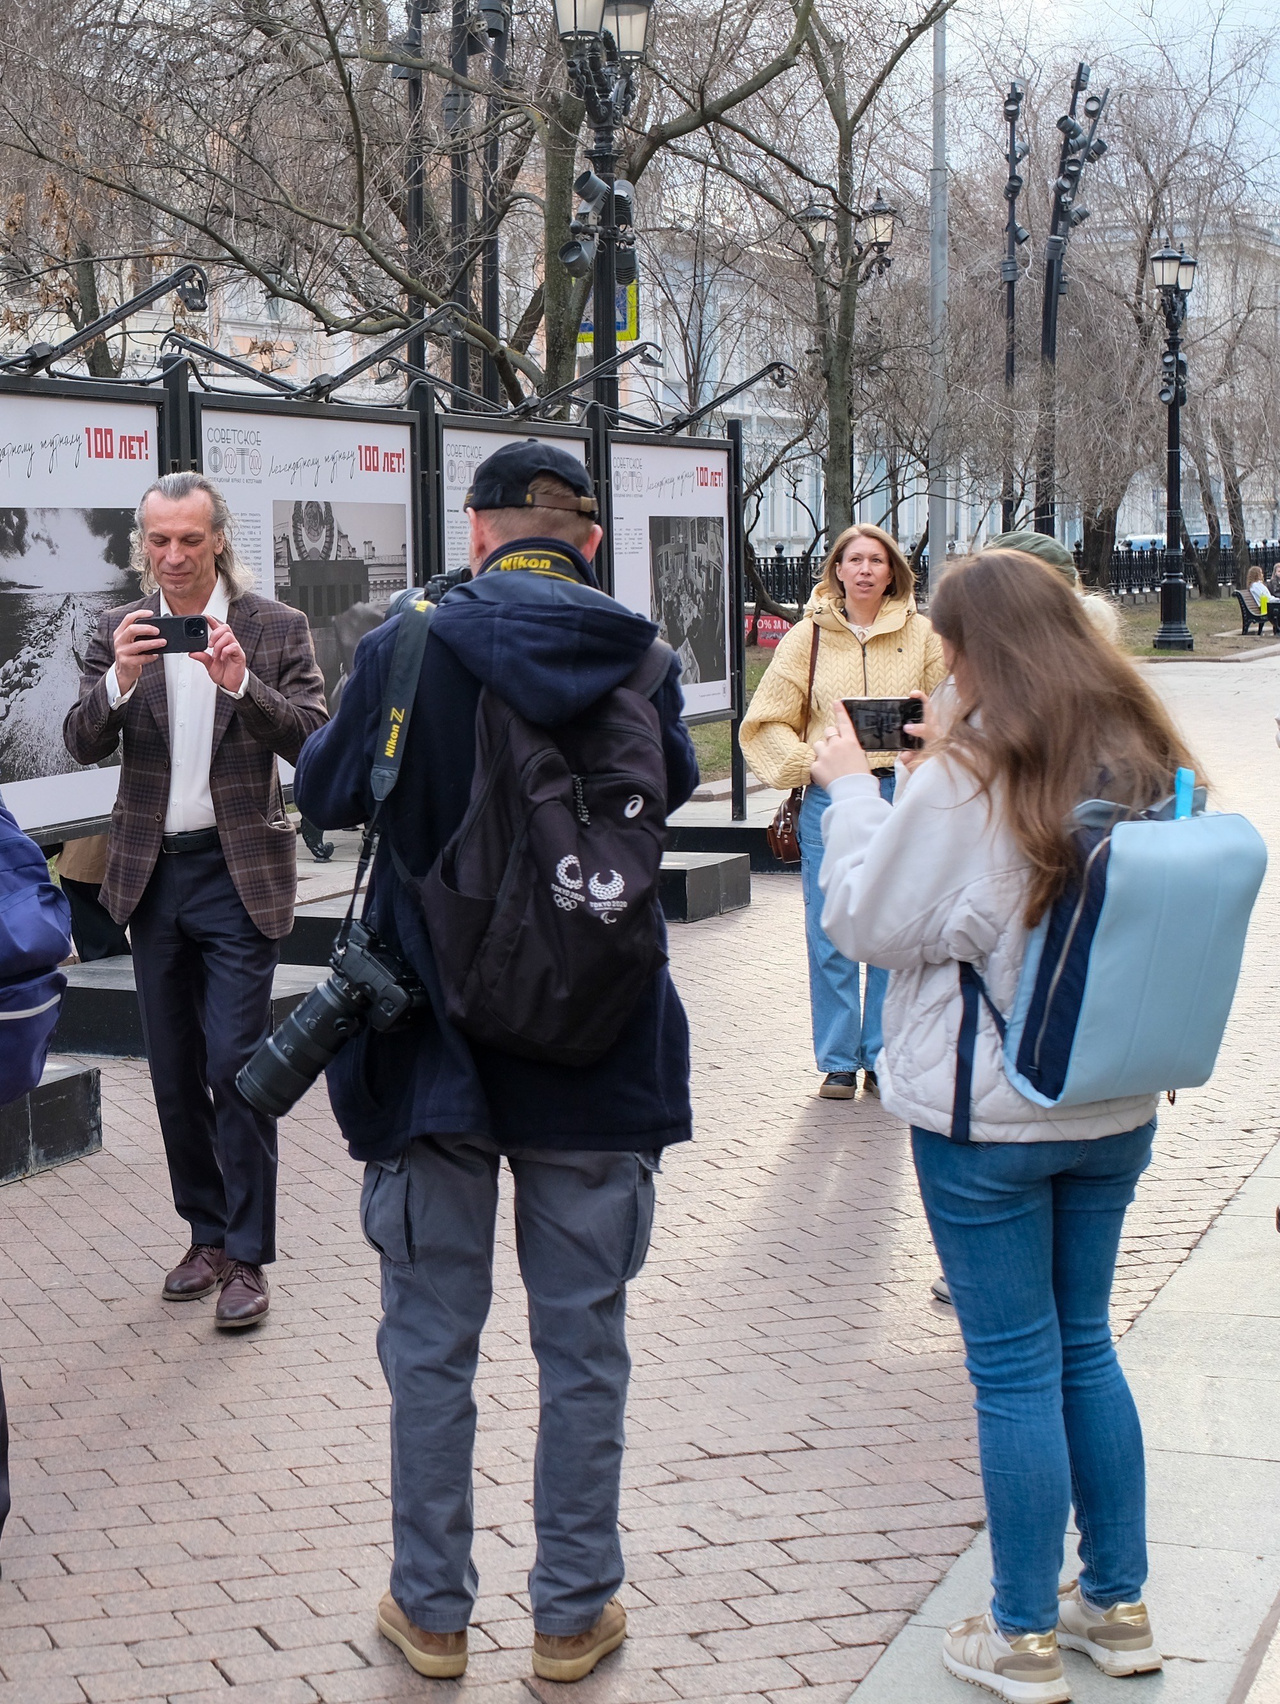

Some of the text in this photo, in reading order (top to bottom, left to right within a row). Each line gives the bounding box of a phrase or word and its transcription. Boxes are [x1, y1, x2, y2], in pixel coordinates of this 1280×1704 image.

[85, 427, 113, 458] 100
[207, 428, 261, 446] СОВЕТСКОЕ
[358, 445, 379, 472] 100
[696, 467, 708, 486] 100
[500, 556, 551, 571] Nikon
[384, 707, 405, 758] Nikon Z
[551, 883, 585, 902] TOKYO 2020
